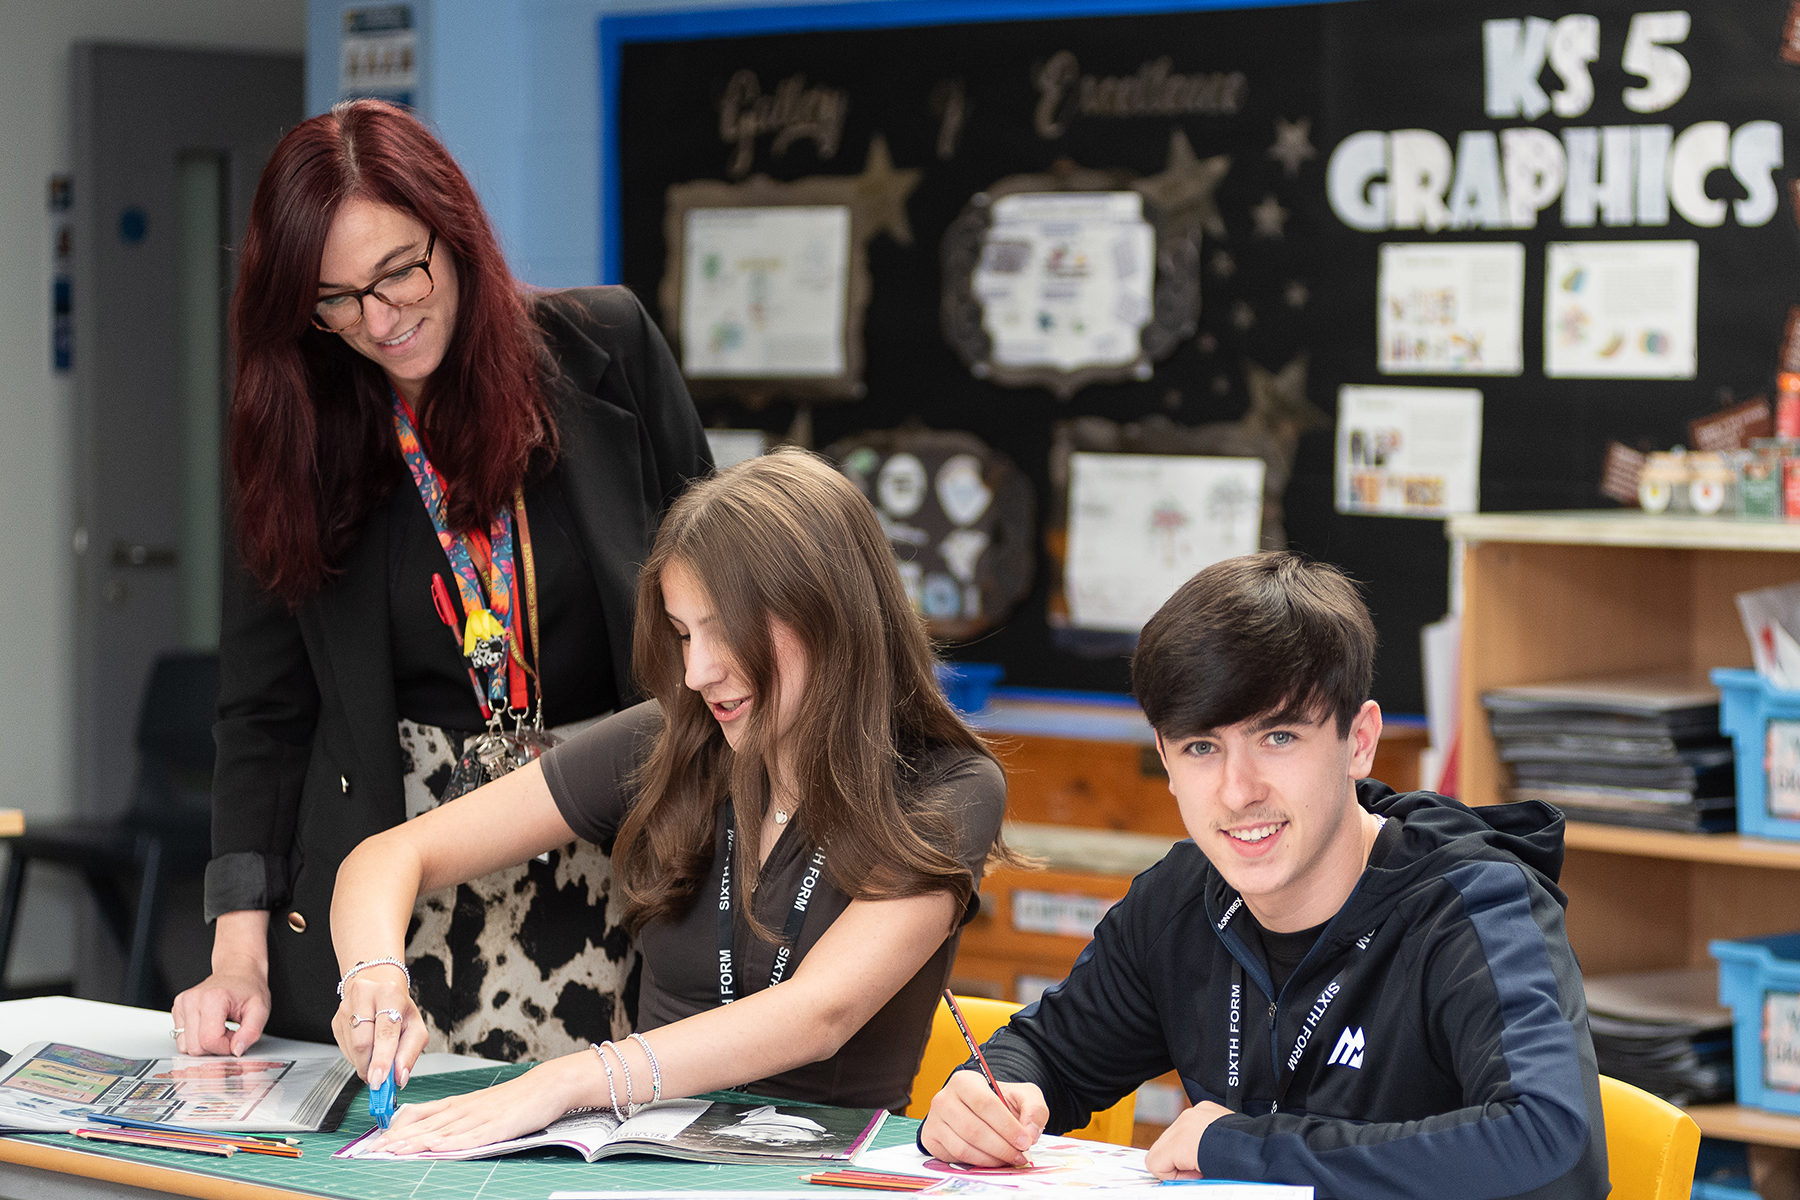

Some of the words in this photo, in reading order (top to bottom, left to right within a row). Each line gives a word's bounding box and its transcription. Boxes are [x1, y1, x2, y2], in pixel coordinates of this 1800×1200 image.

[1482, 14, 1600, 120] KS
[1621, 10, 1692, 113] 5
[1326, 120, 1783, 232] GRAPHICS
[719, 866, 730, 911] SIXTH
[794, 867, 820, 912] FORM
[719, 949, 734, 995] FORM
[1230, 984, 1241, 1033] FORM
[1305, 981, 1341, 1027] SIXTH
[1228, 1038, 1240, 1088] SIXTH
[1287, 1026, 1312, 1072] FORM
